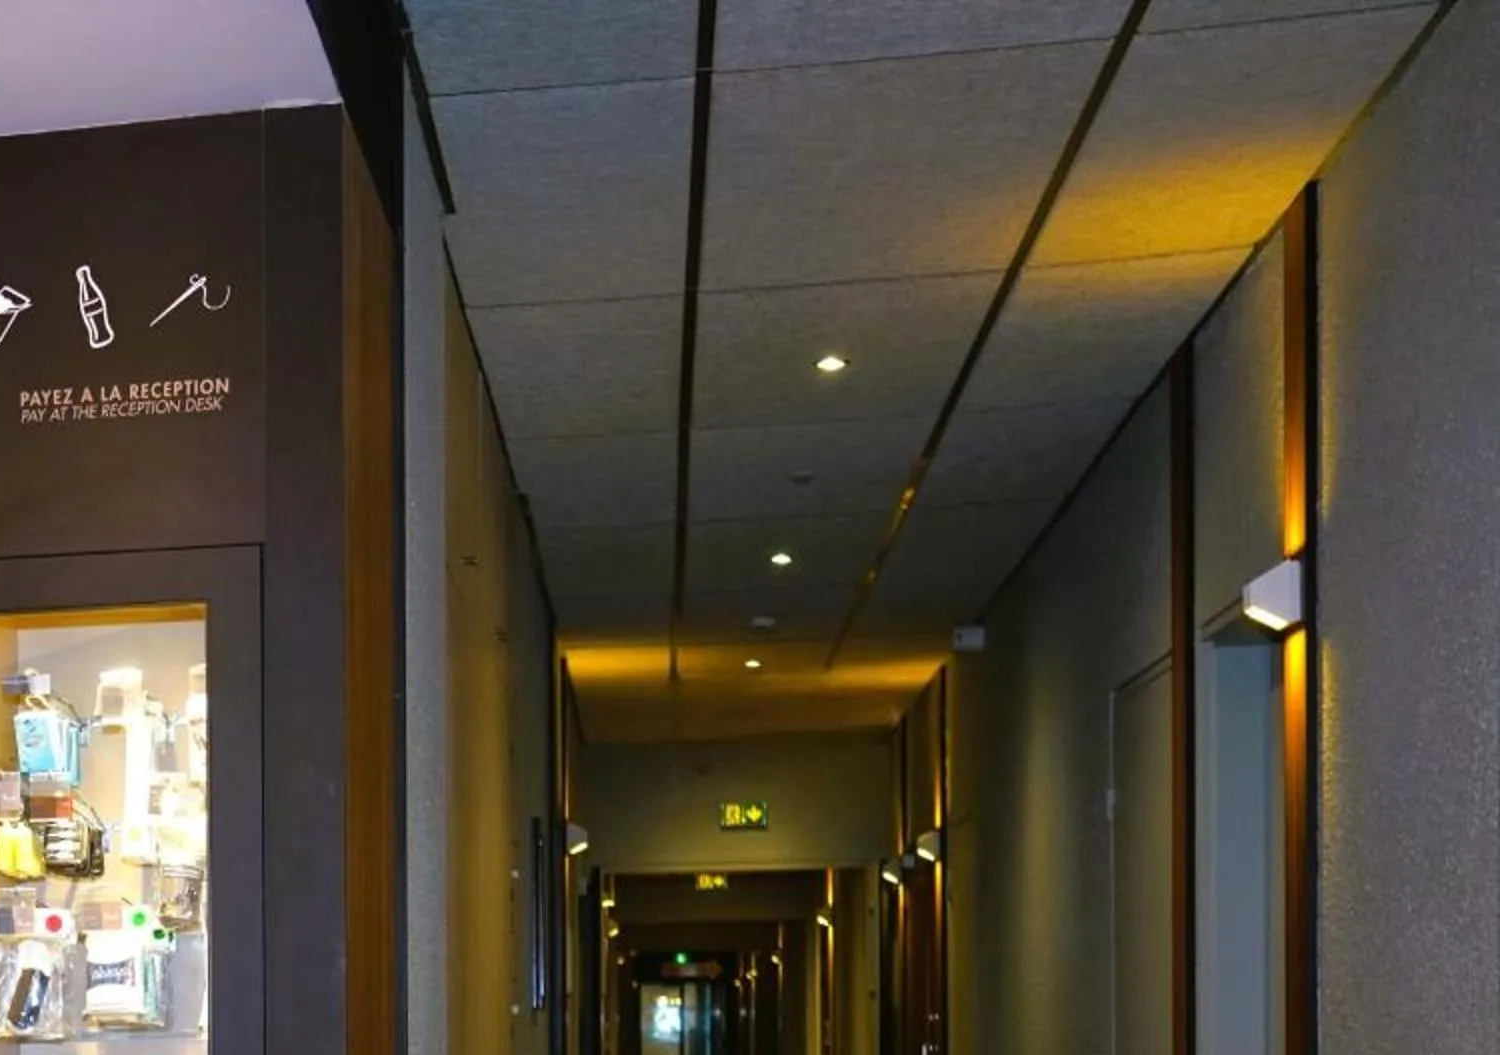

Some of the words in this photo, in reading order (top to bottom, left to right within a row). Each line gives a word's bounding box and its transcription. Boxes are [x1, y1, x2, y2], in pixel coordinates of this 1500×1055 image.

[19, 387, 74, 407] PAYEZ
[80, 386, 94, 403] A
[100, 384, 121, 401] LA
[128, 376, 230, 399] RECEPTION
[20, 408, 47, 424] PAY
[49, 406, 69, 422] AT
[72, 404, 98, 420] THE
[100, 399, 181, 418] RECEPTION
[184, 395, 224, 413] DESK
